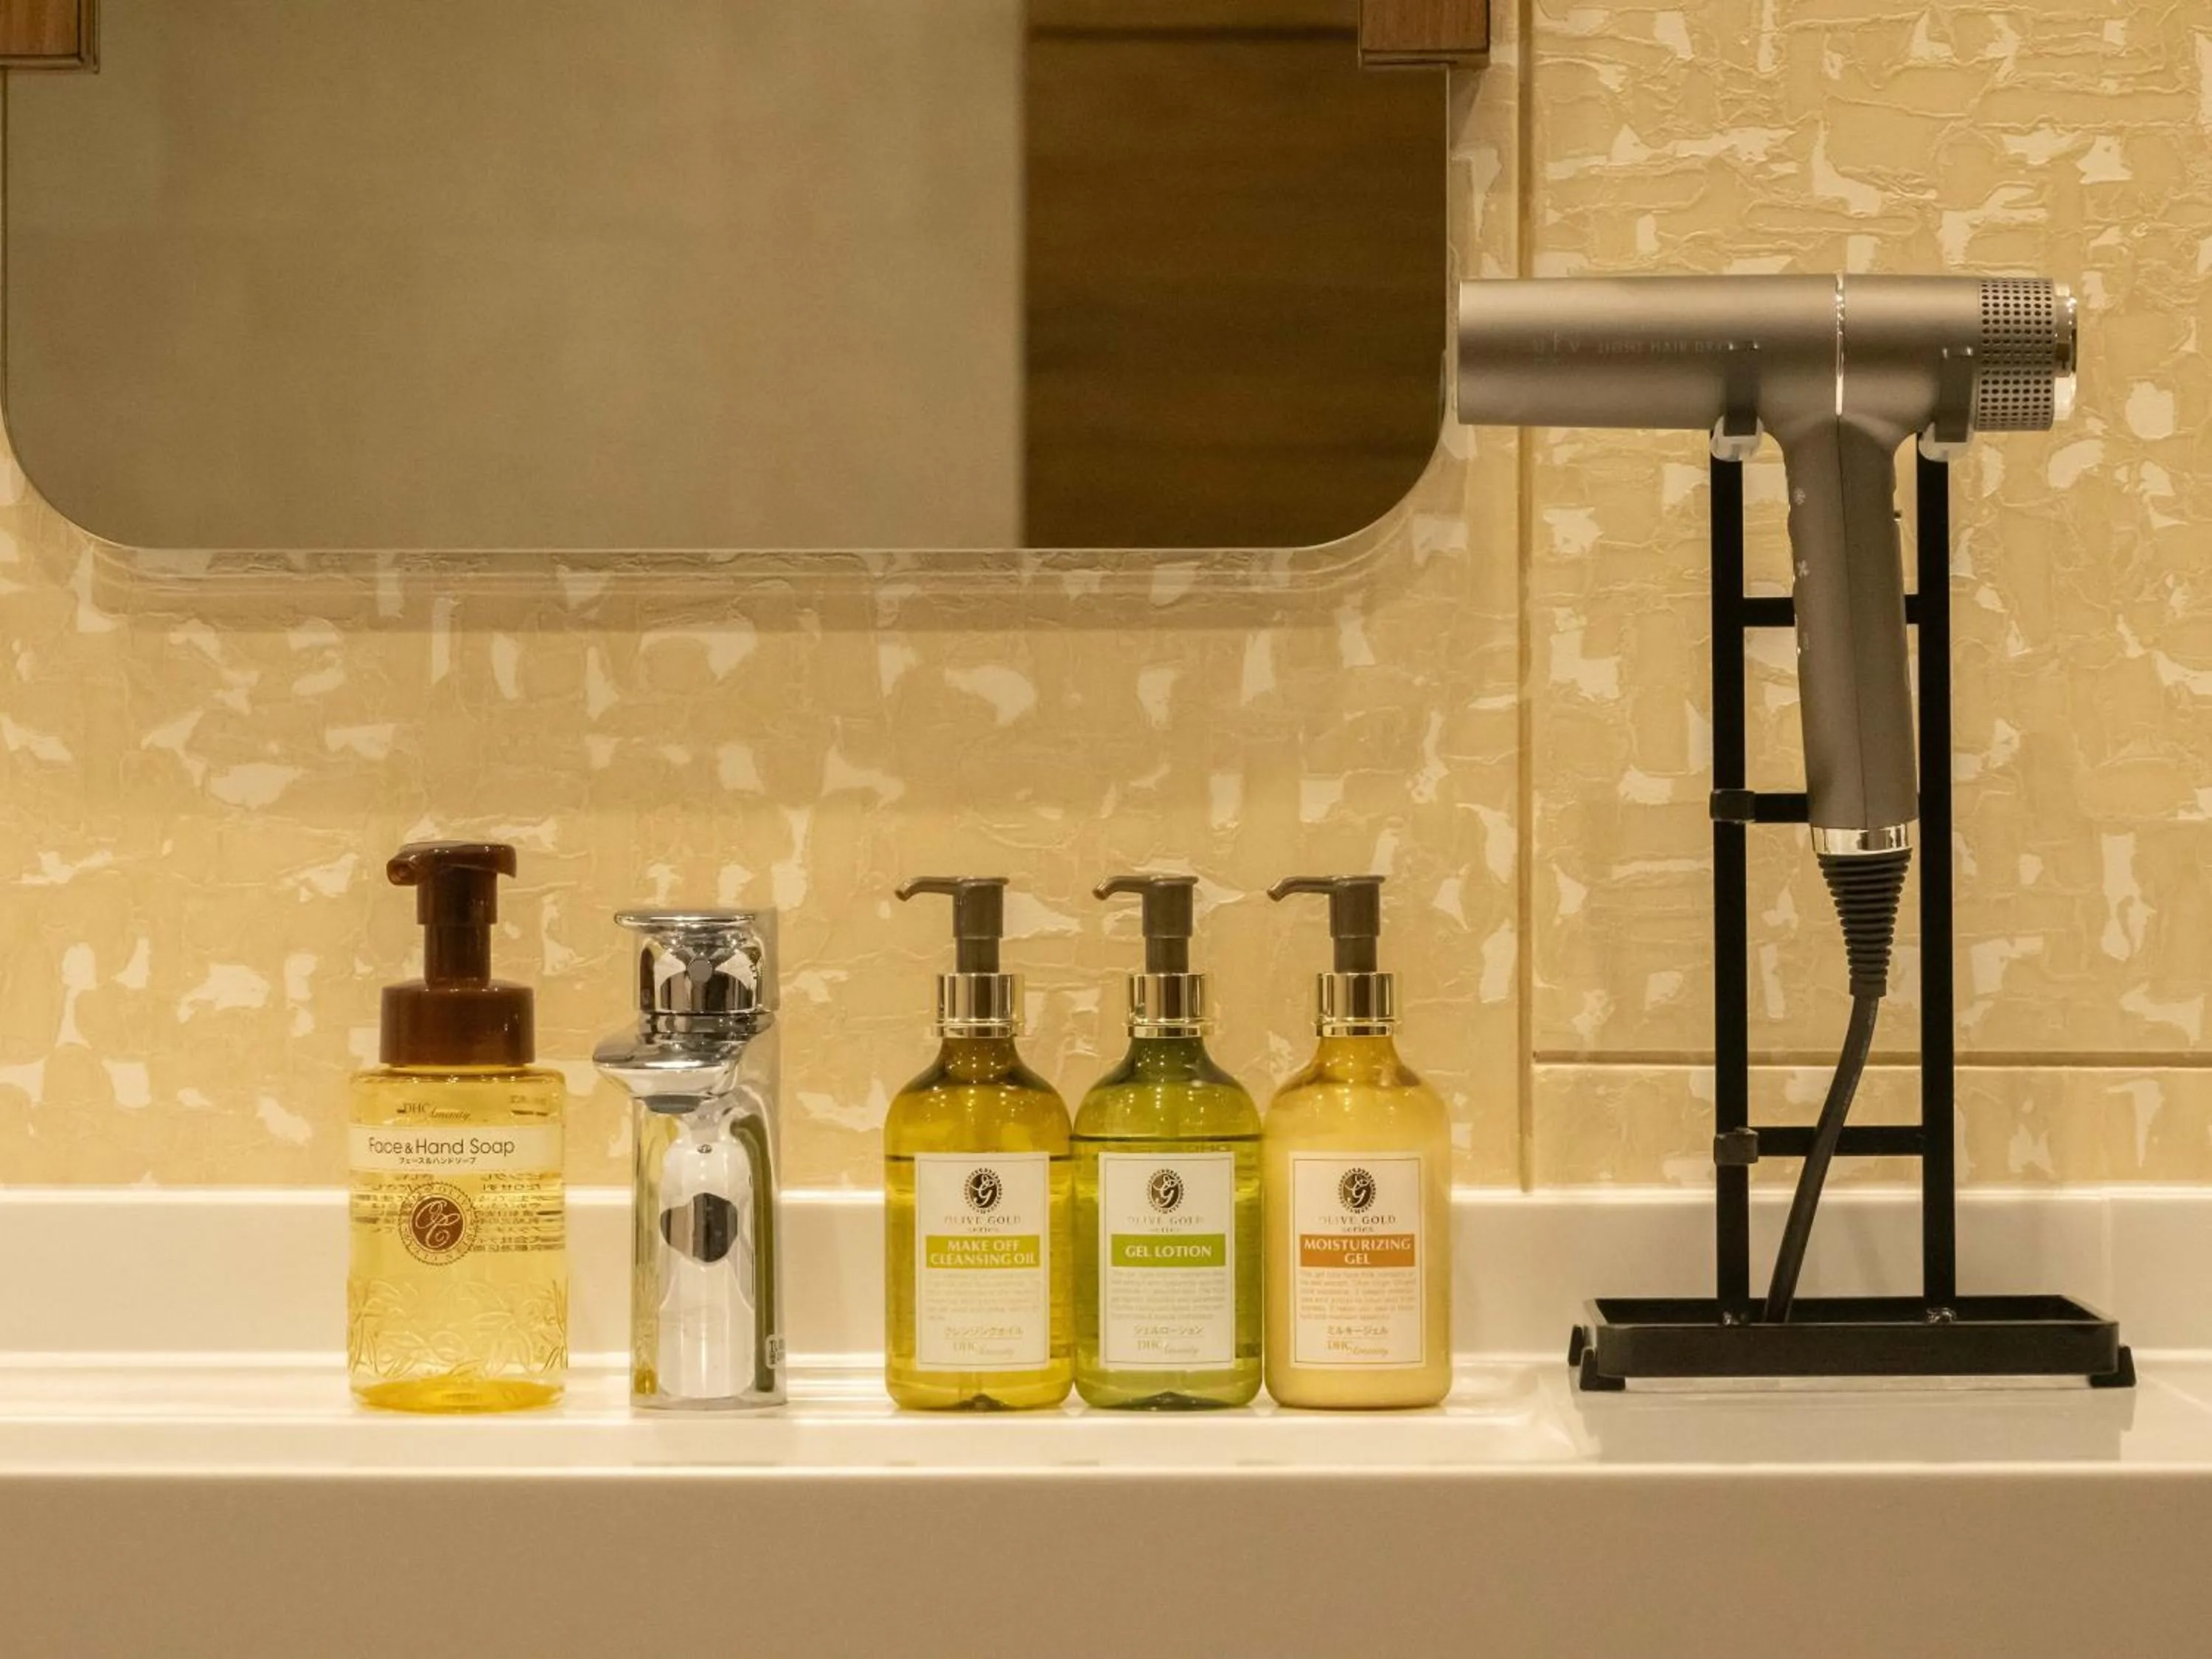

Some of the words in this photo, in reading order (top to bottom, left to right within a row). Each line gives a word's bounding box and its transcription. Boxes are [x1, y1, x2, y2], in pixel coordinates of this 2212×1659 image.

[470, 1137, 515, 1156] Soap
[987, 1215, 1022, 1225] GOLD
[1362, 1215, 1396, 1225] GOLD
[947, 1239, 988, 1252] MAKE
[992, 1239, 1020, 1252] OFF
[1303, 1237, 1411, 1251] MOISTURIZING
[1124, 1245, 1152, 1258] GEL
[1155, 1245, 1211, 1257] LOTION
[930, 1253, 1011, 1265] CLEANSING
[1013, 1252, 1036, 1265] OIL
[1343, 1252, 1371, 1265] GEL
